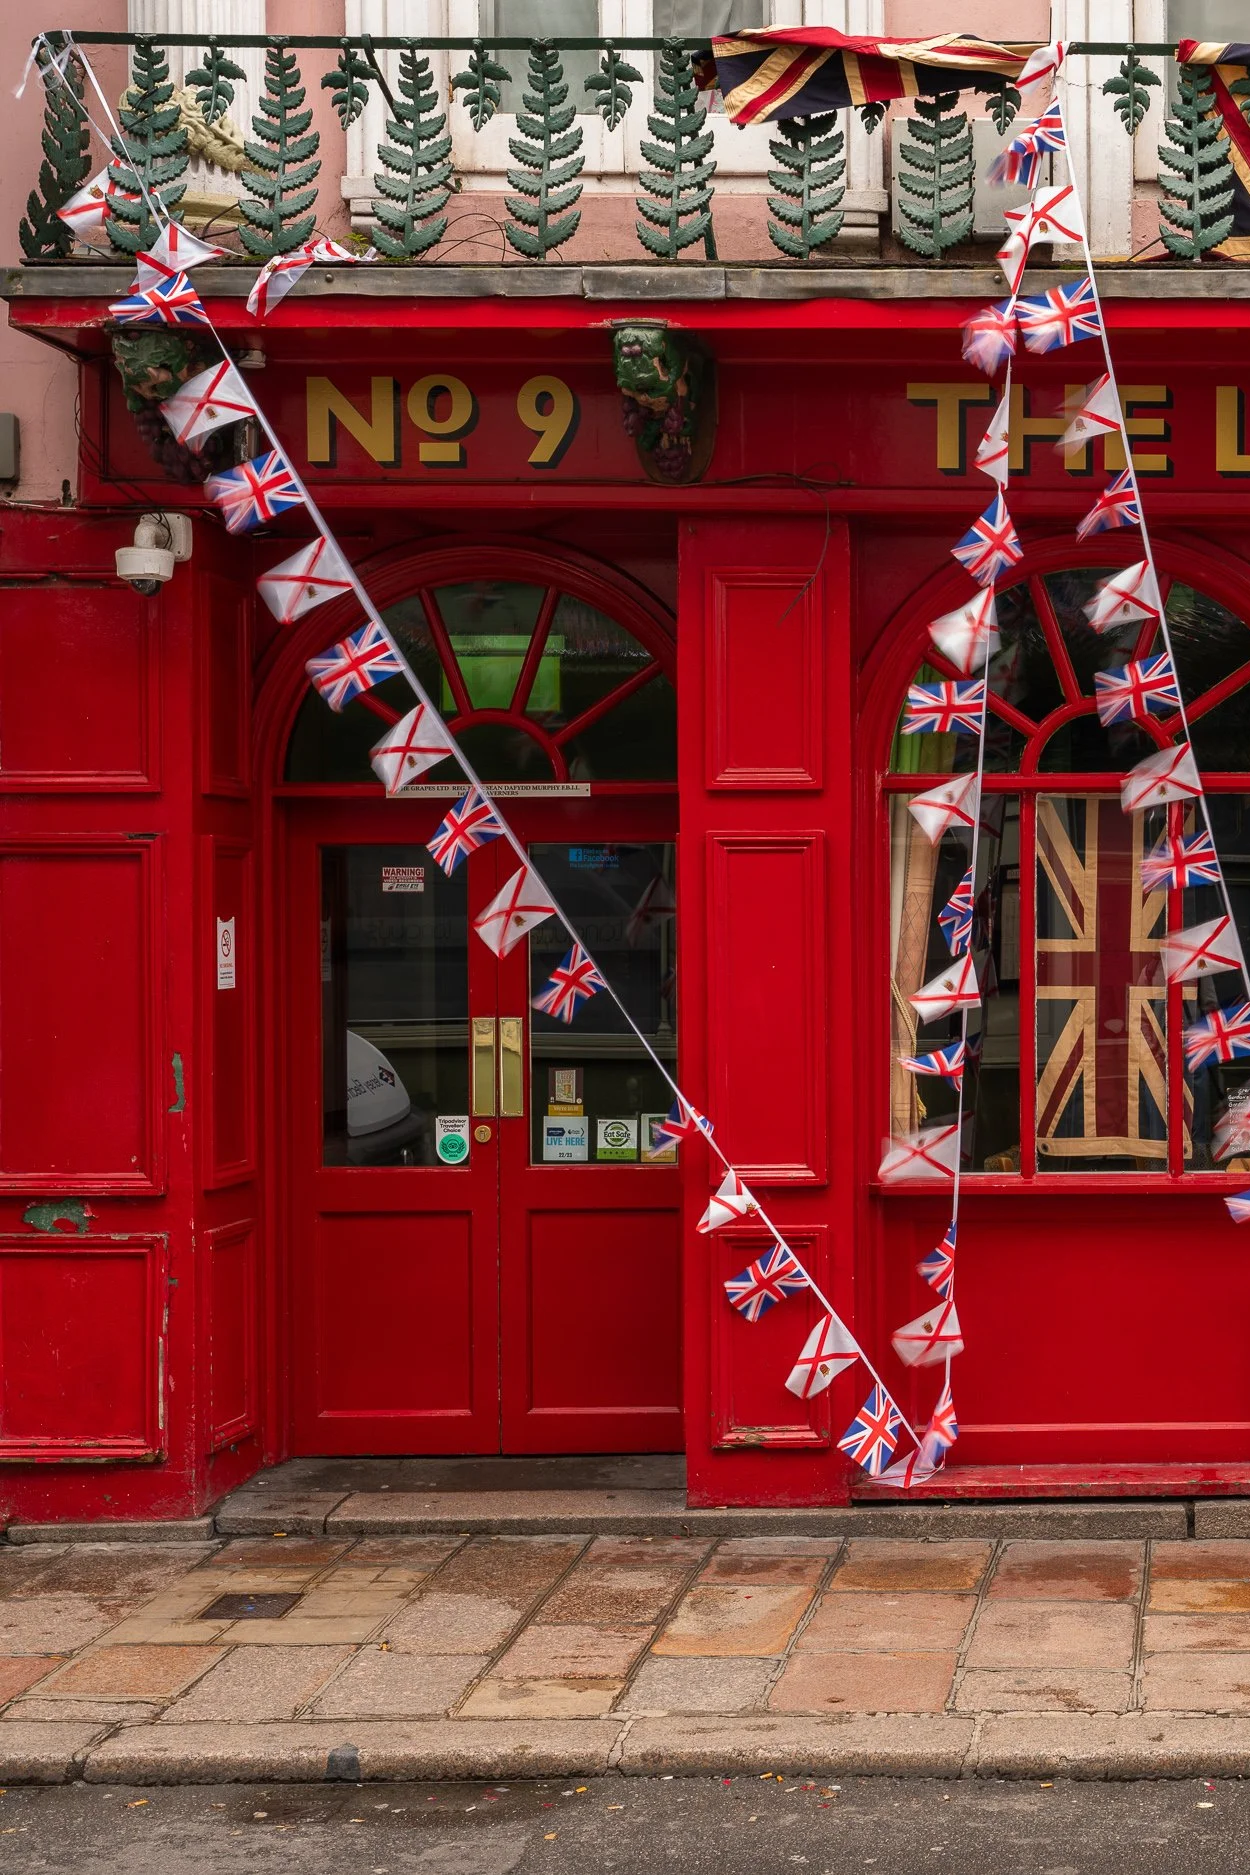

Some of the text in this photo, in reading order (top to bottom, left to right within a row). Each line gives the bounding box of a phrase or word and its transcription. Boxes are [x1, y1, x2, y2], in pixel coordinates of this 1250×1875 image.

[517, 375, 574, 463] 9
[907, 383, 1168, 471] THE
[384, 868, 424, 876] WARNING!
[616, 1131, 631, 1139] Safe
[546, 1137, 585, 1146] LIVE HERE
